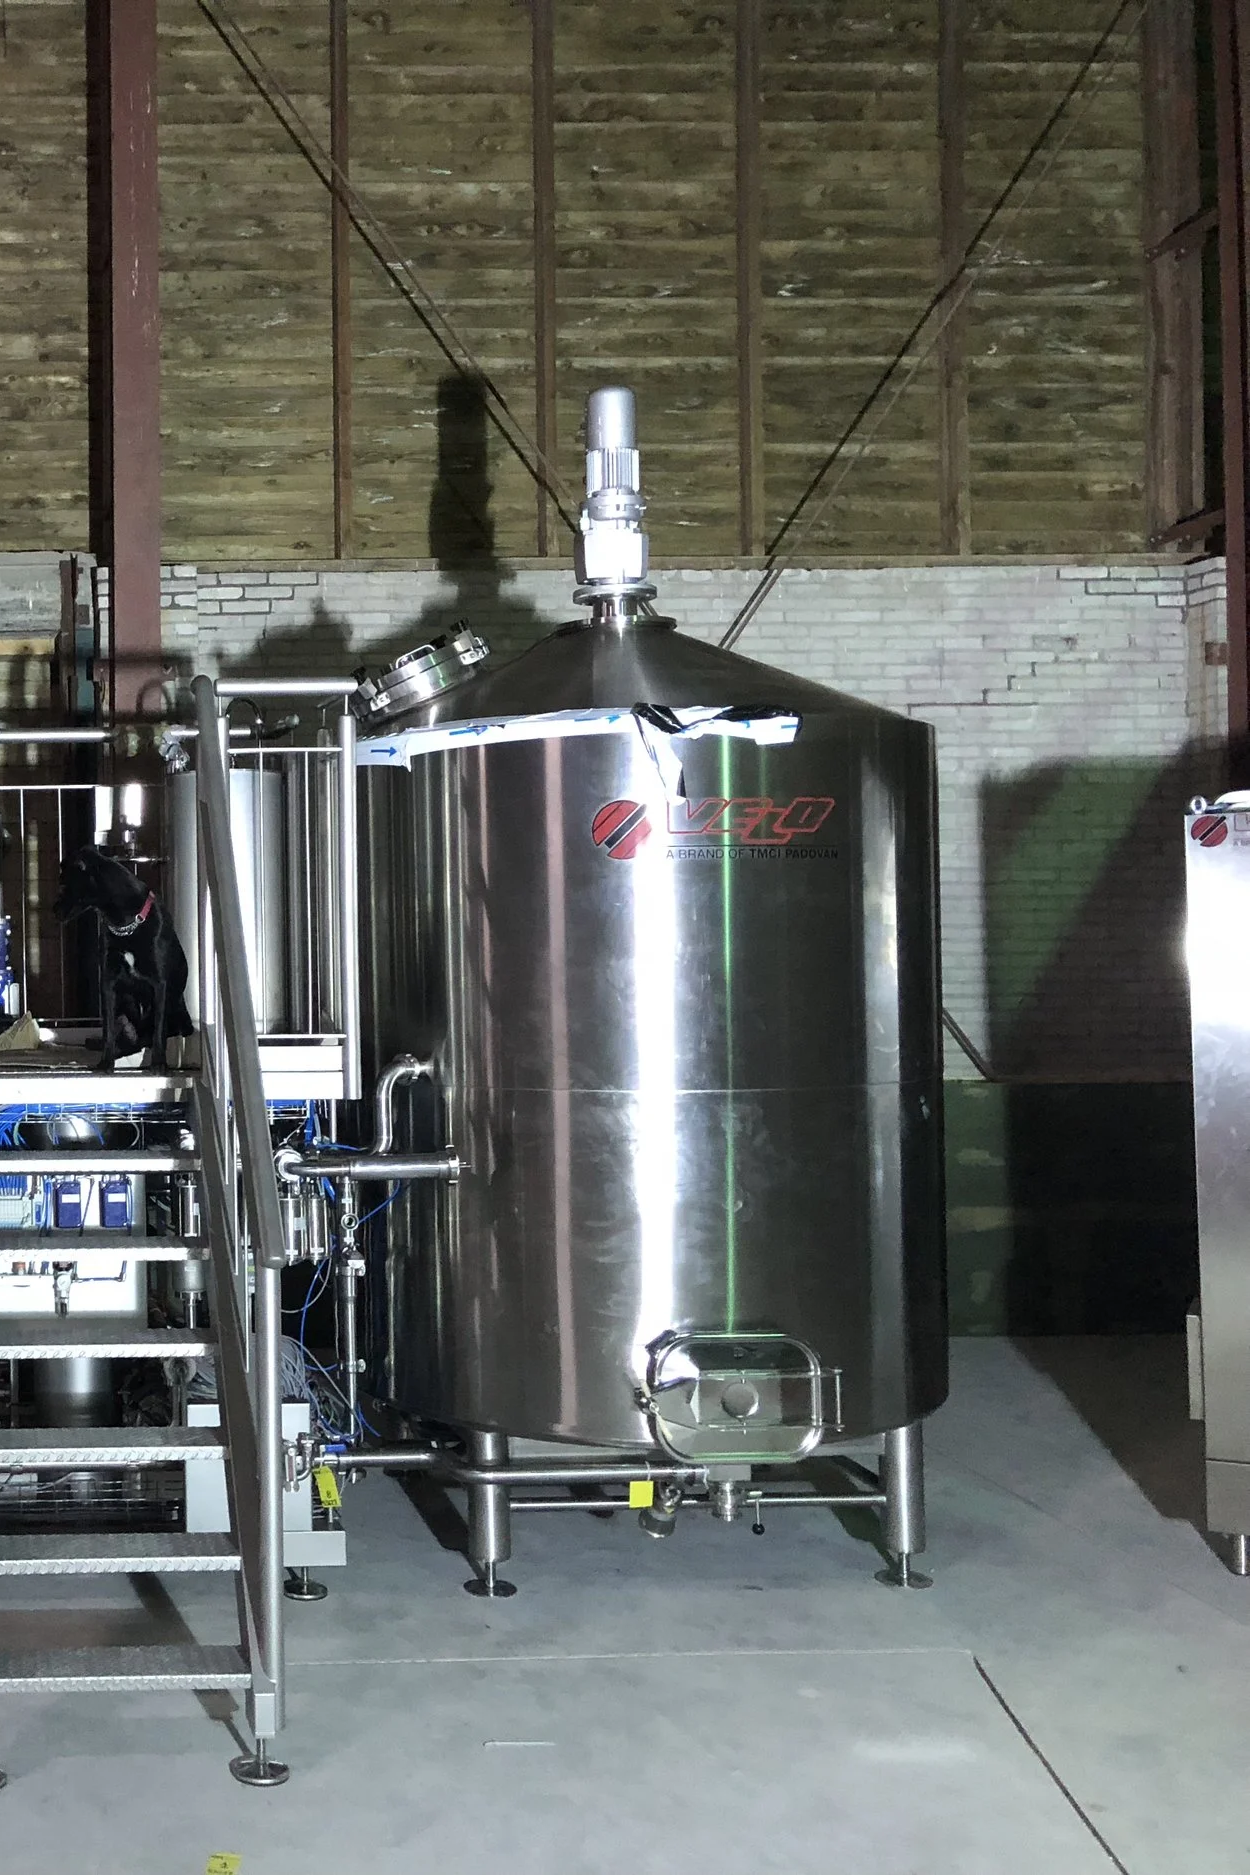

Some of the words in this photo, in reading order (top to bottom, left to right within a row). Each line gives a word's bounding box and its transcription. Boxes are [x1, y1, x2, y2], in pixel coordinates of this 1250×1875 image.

[666, 850, 674, 860] A
[678, 849, 724, 860] BRAND
[729, 849, 745, 860] OF
[750, 849, 781, 860] TMCI
[785, 849, 839, 860] PADOVAN
